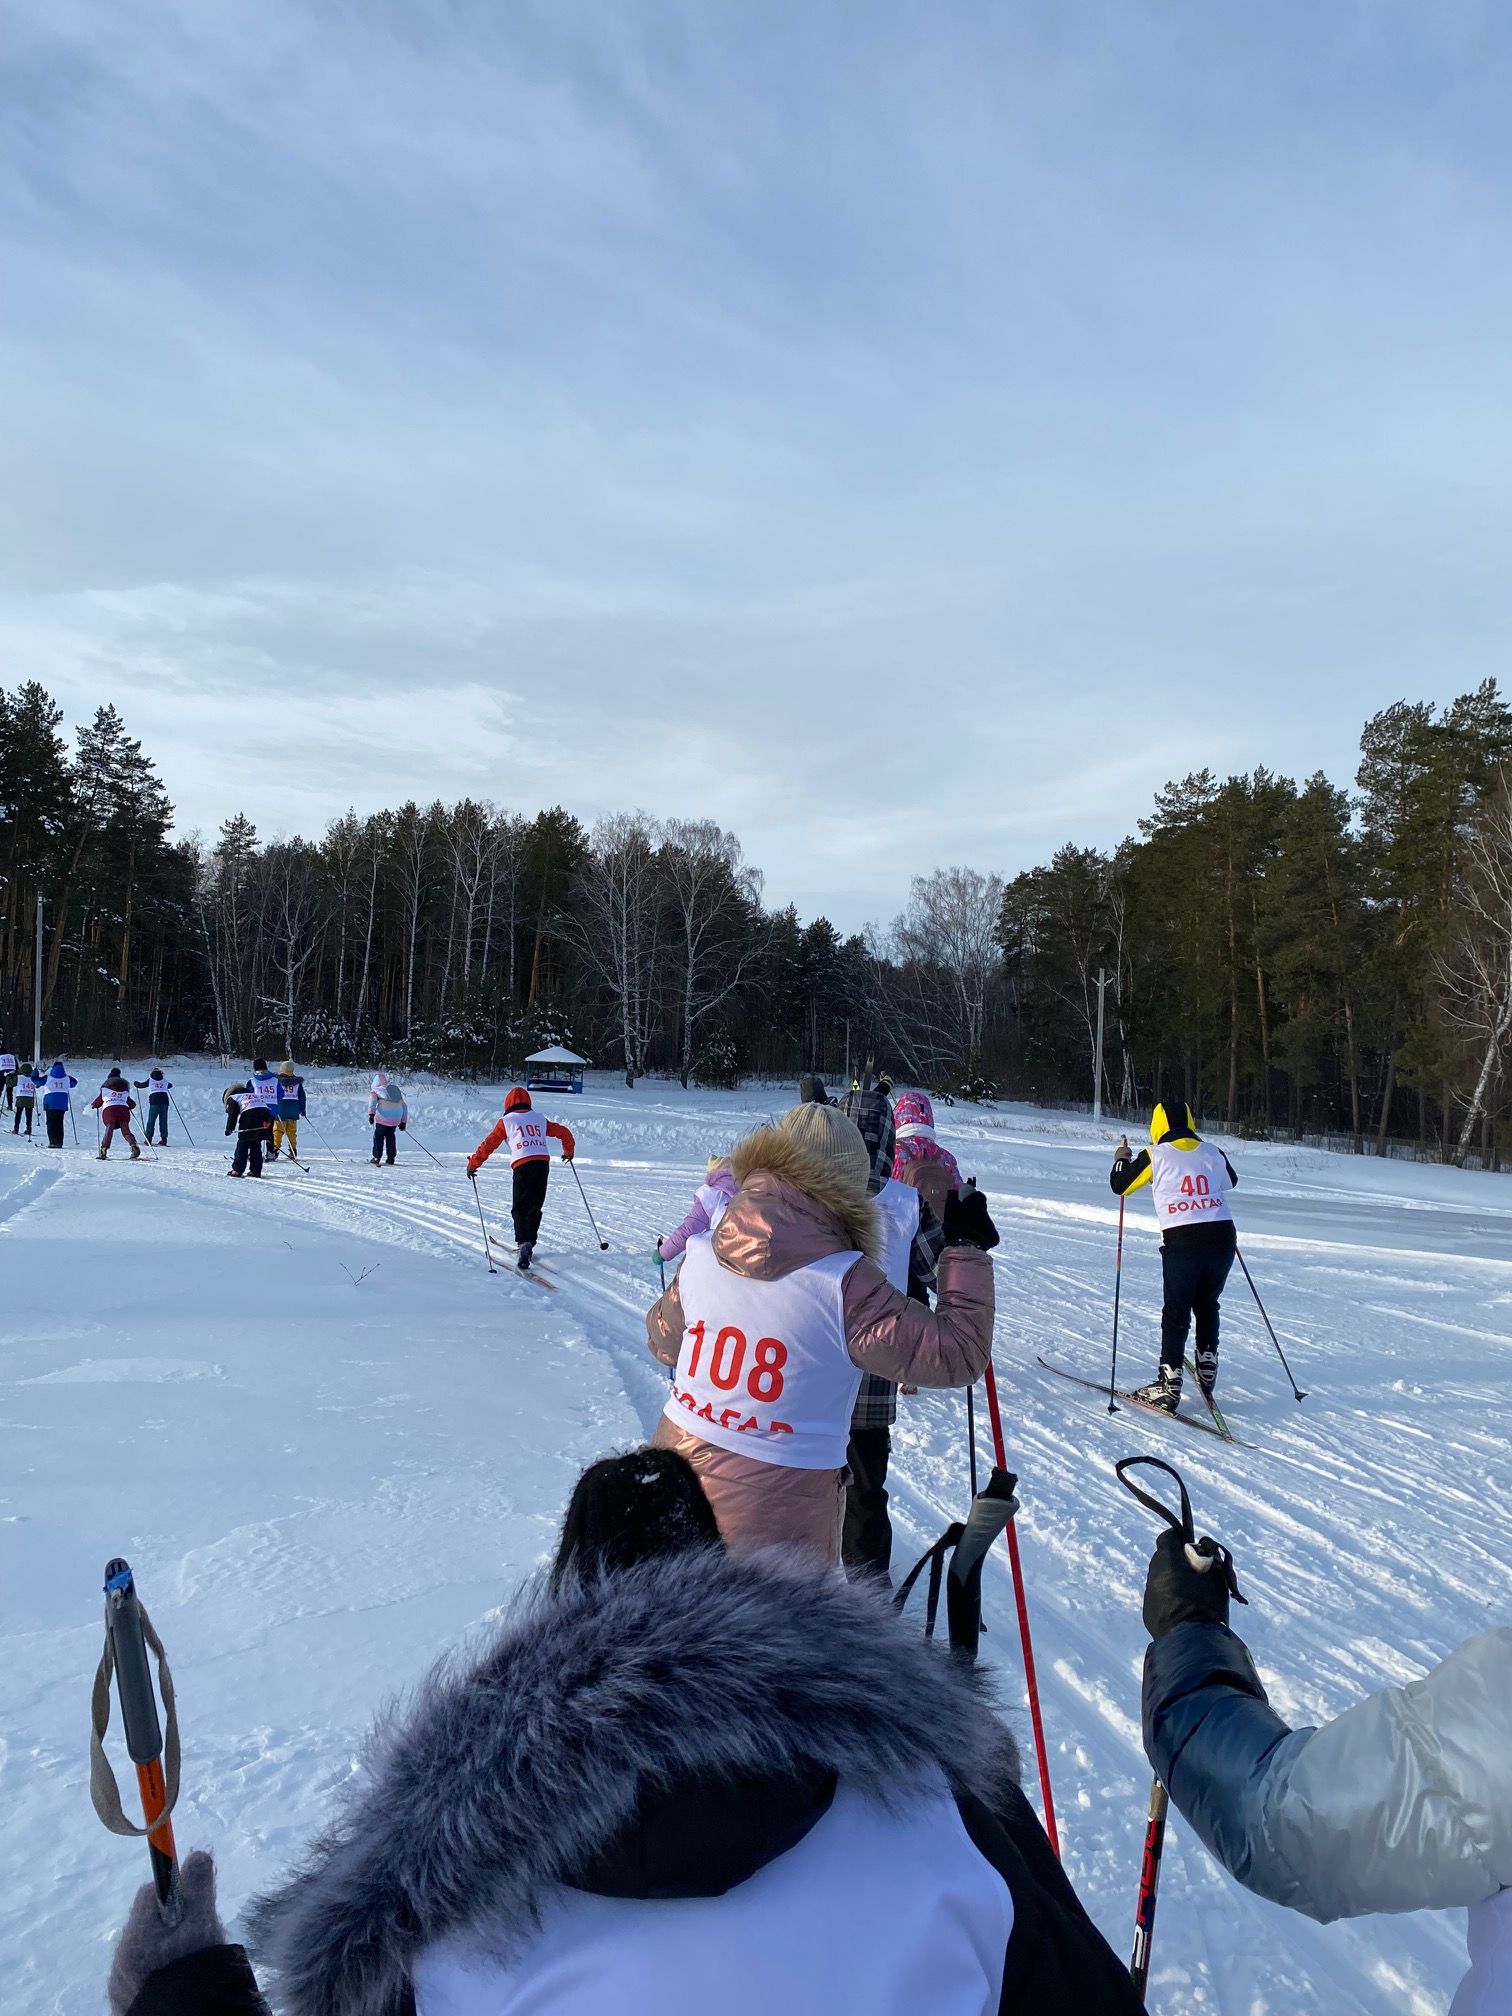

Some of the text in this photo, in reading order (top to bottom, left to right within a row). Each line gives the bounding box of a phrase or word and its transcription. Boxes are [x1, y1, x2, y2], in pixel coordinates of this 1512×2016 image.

[258, 1085, 275, 1094] 145
[516, 1124, 541, 1138] 105
[1181, 1174, 1210, 1197] 40
[687, 1319, 788, 1403] 108
